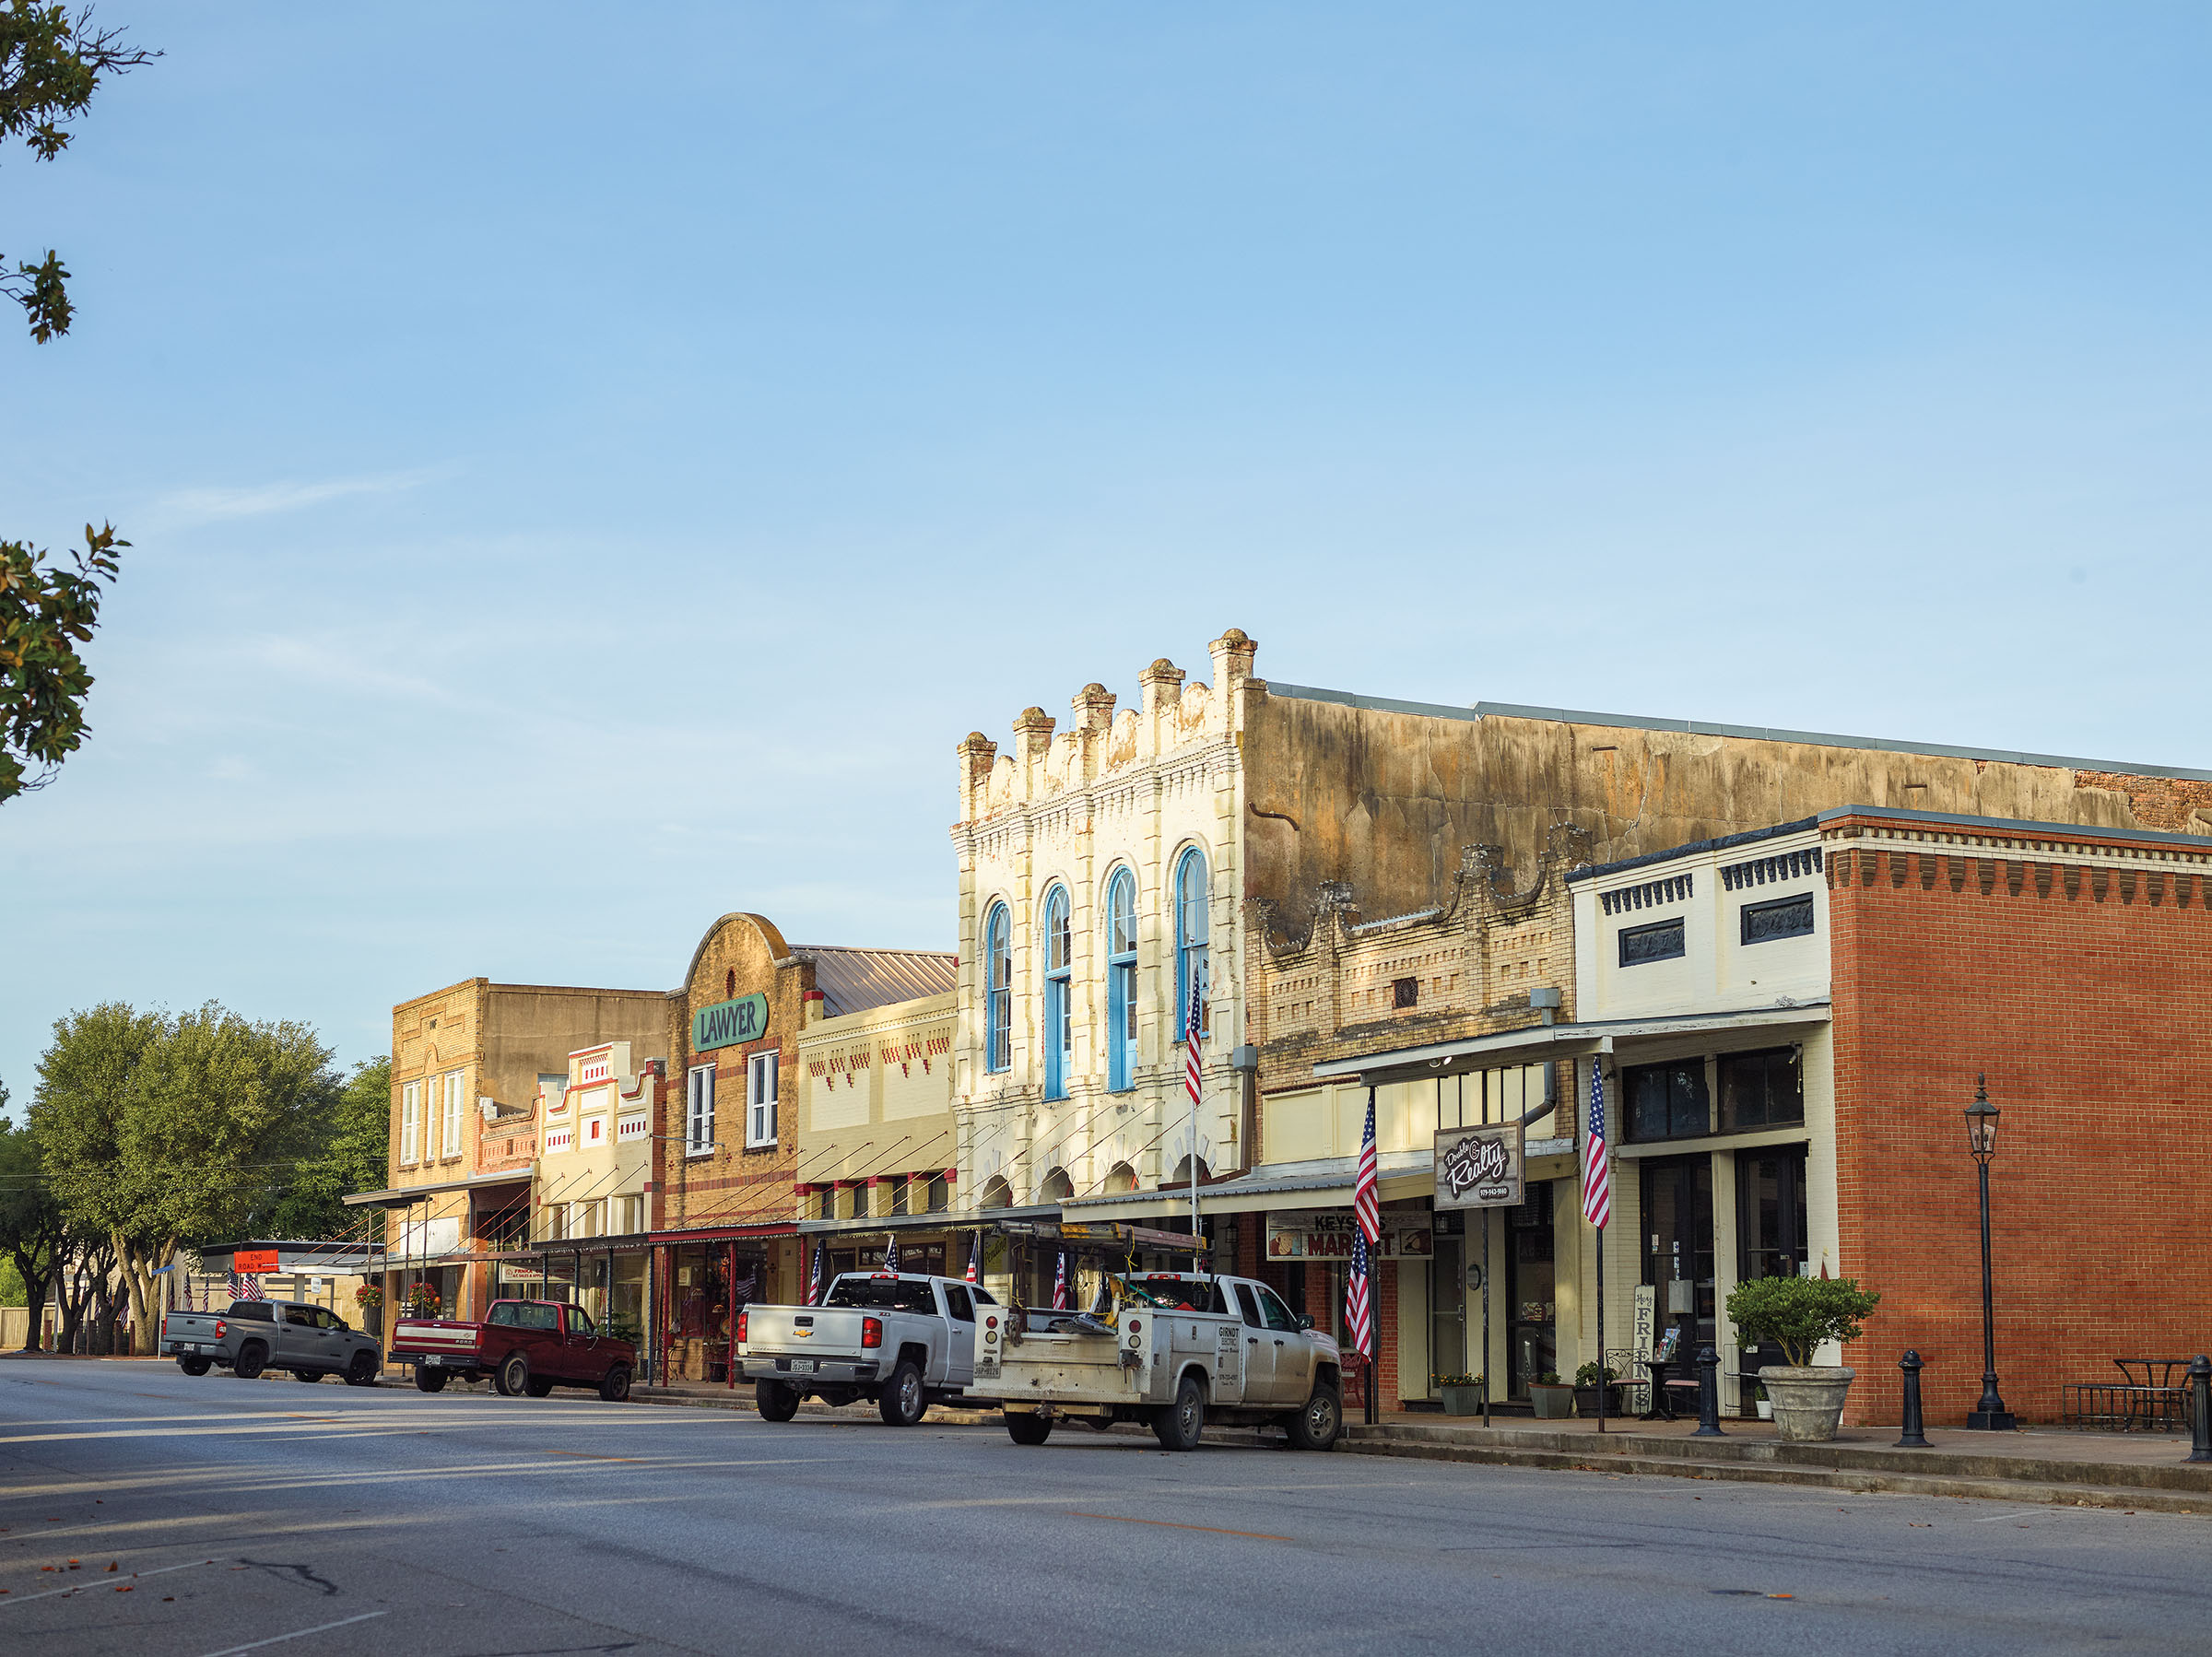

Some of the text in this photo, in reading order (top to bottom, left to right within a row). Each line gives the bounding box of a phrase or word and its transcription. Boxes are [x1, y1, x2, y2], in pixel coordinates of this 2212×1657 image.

[700, 1001, 757, 1044] LAWYER
[1445, 1142, 1469, 1166] Double
[1447, 1142, 1506, 1194] Realty
[1314, 1216, 1386, 1231] KEYSS
[1308, 1233, 1395, 1256] MART
[1636, 1294, 1653, 1307] Hey
[1218, 1326, 1240, 1337] GIRNDT
